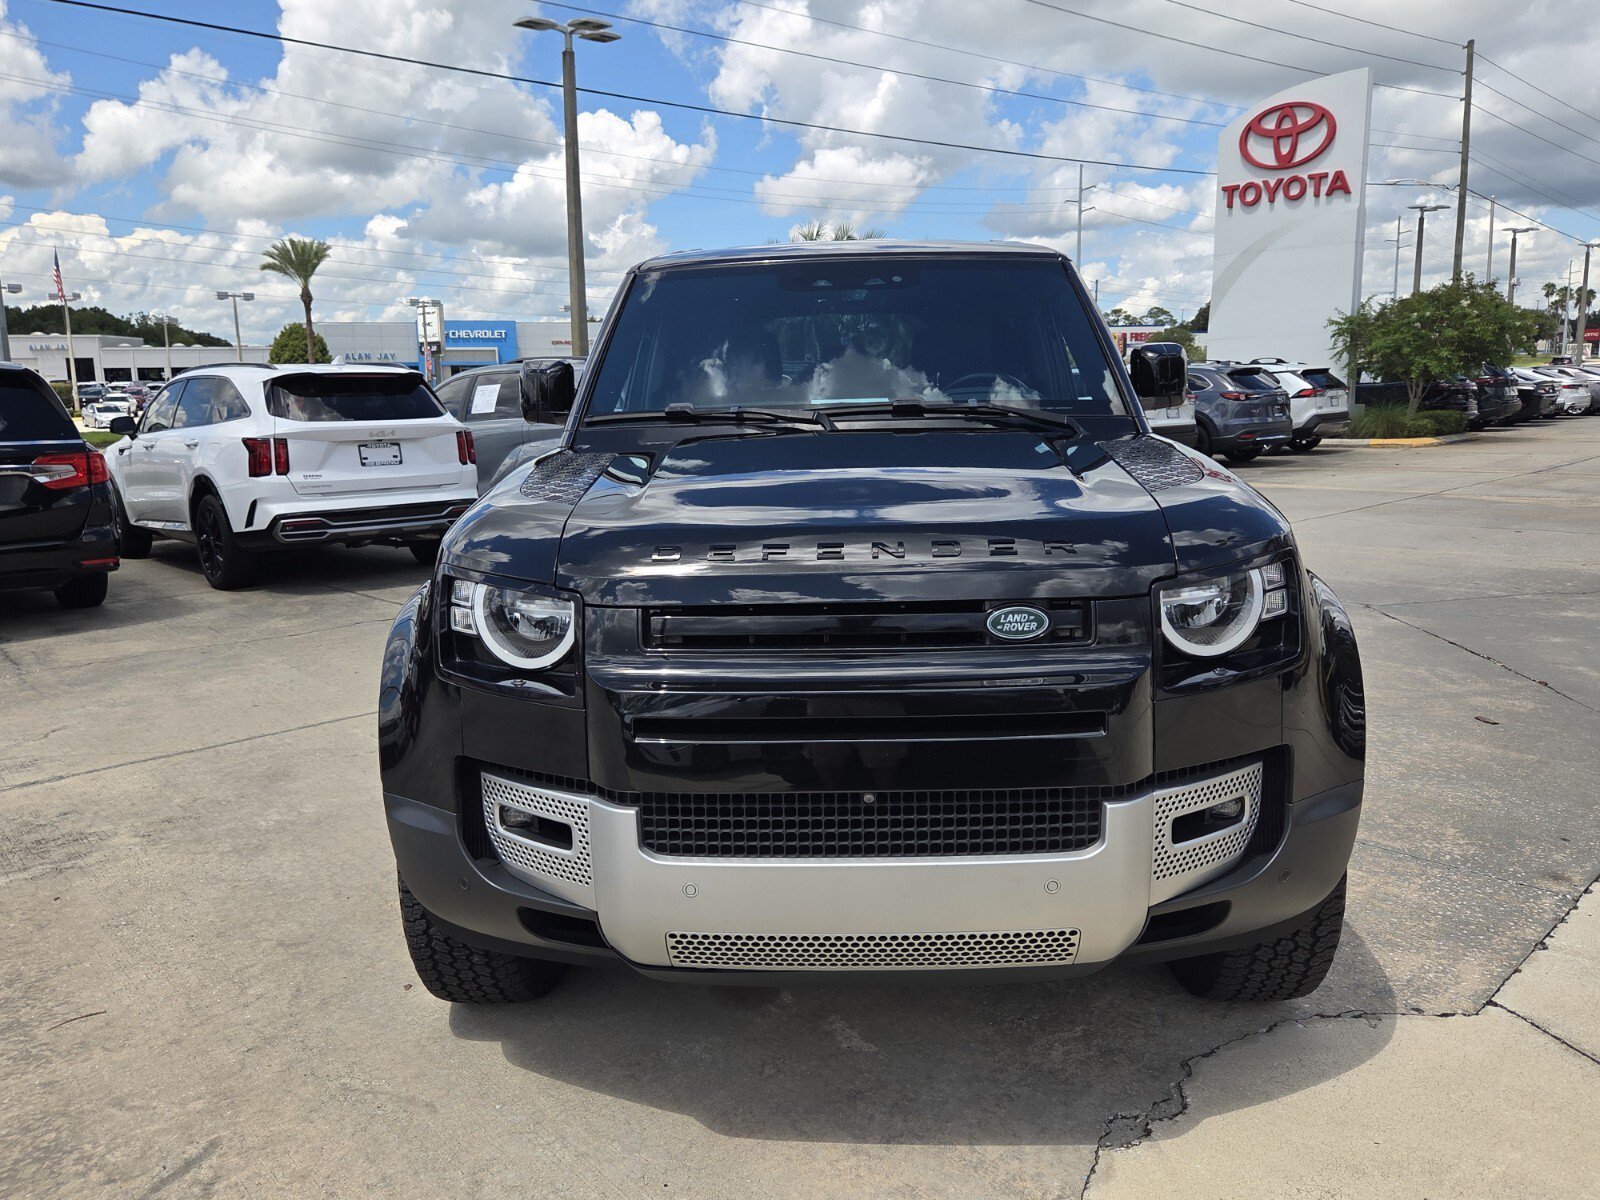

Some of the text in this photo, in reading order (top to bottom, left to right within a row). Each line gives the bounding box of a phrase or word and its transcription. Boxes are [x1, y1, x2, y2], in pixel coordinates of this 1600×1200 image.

[1222, 170, 1351, 209] TOYOTA
[449, 330, 506, 338] CHEVROLET
[650, 537, 1078, 563] DEFENDER
[1000, 614, 1028, 623] LAND
[1003, 622, 1037, 631] ROVER
